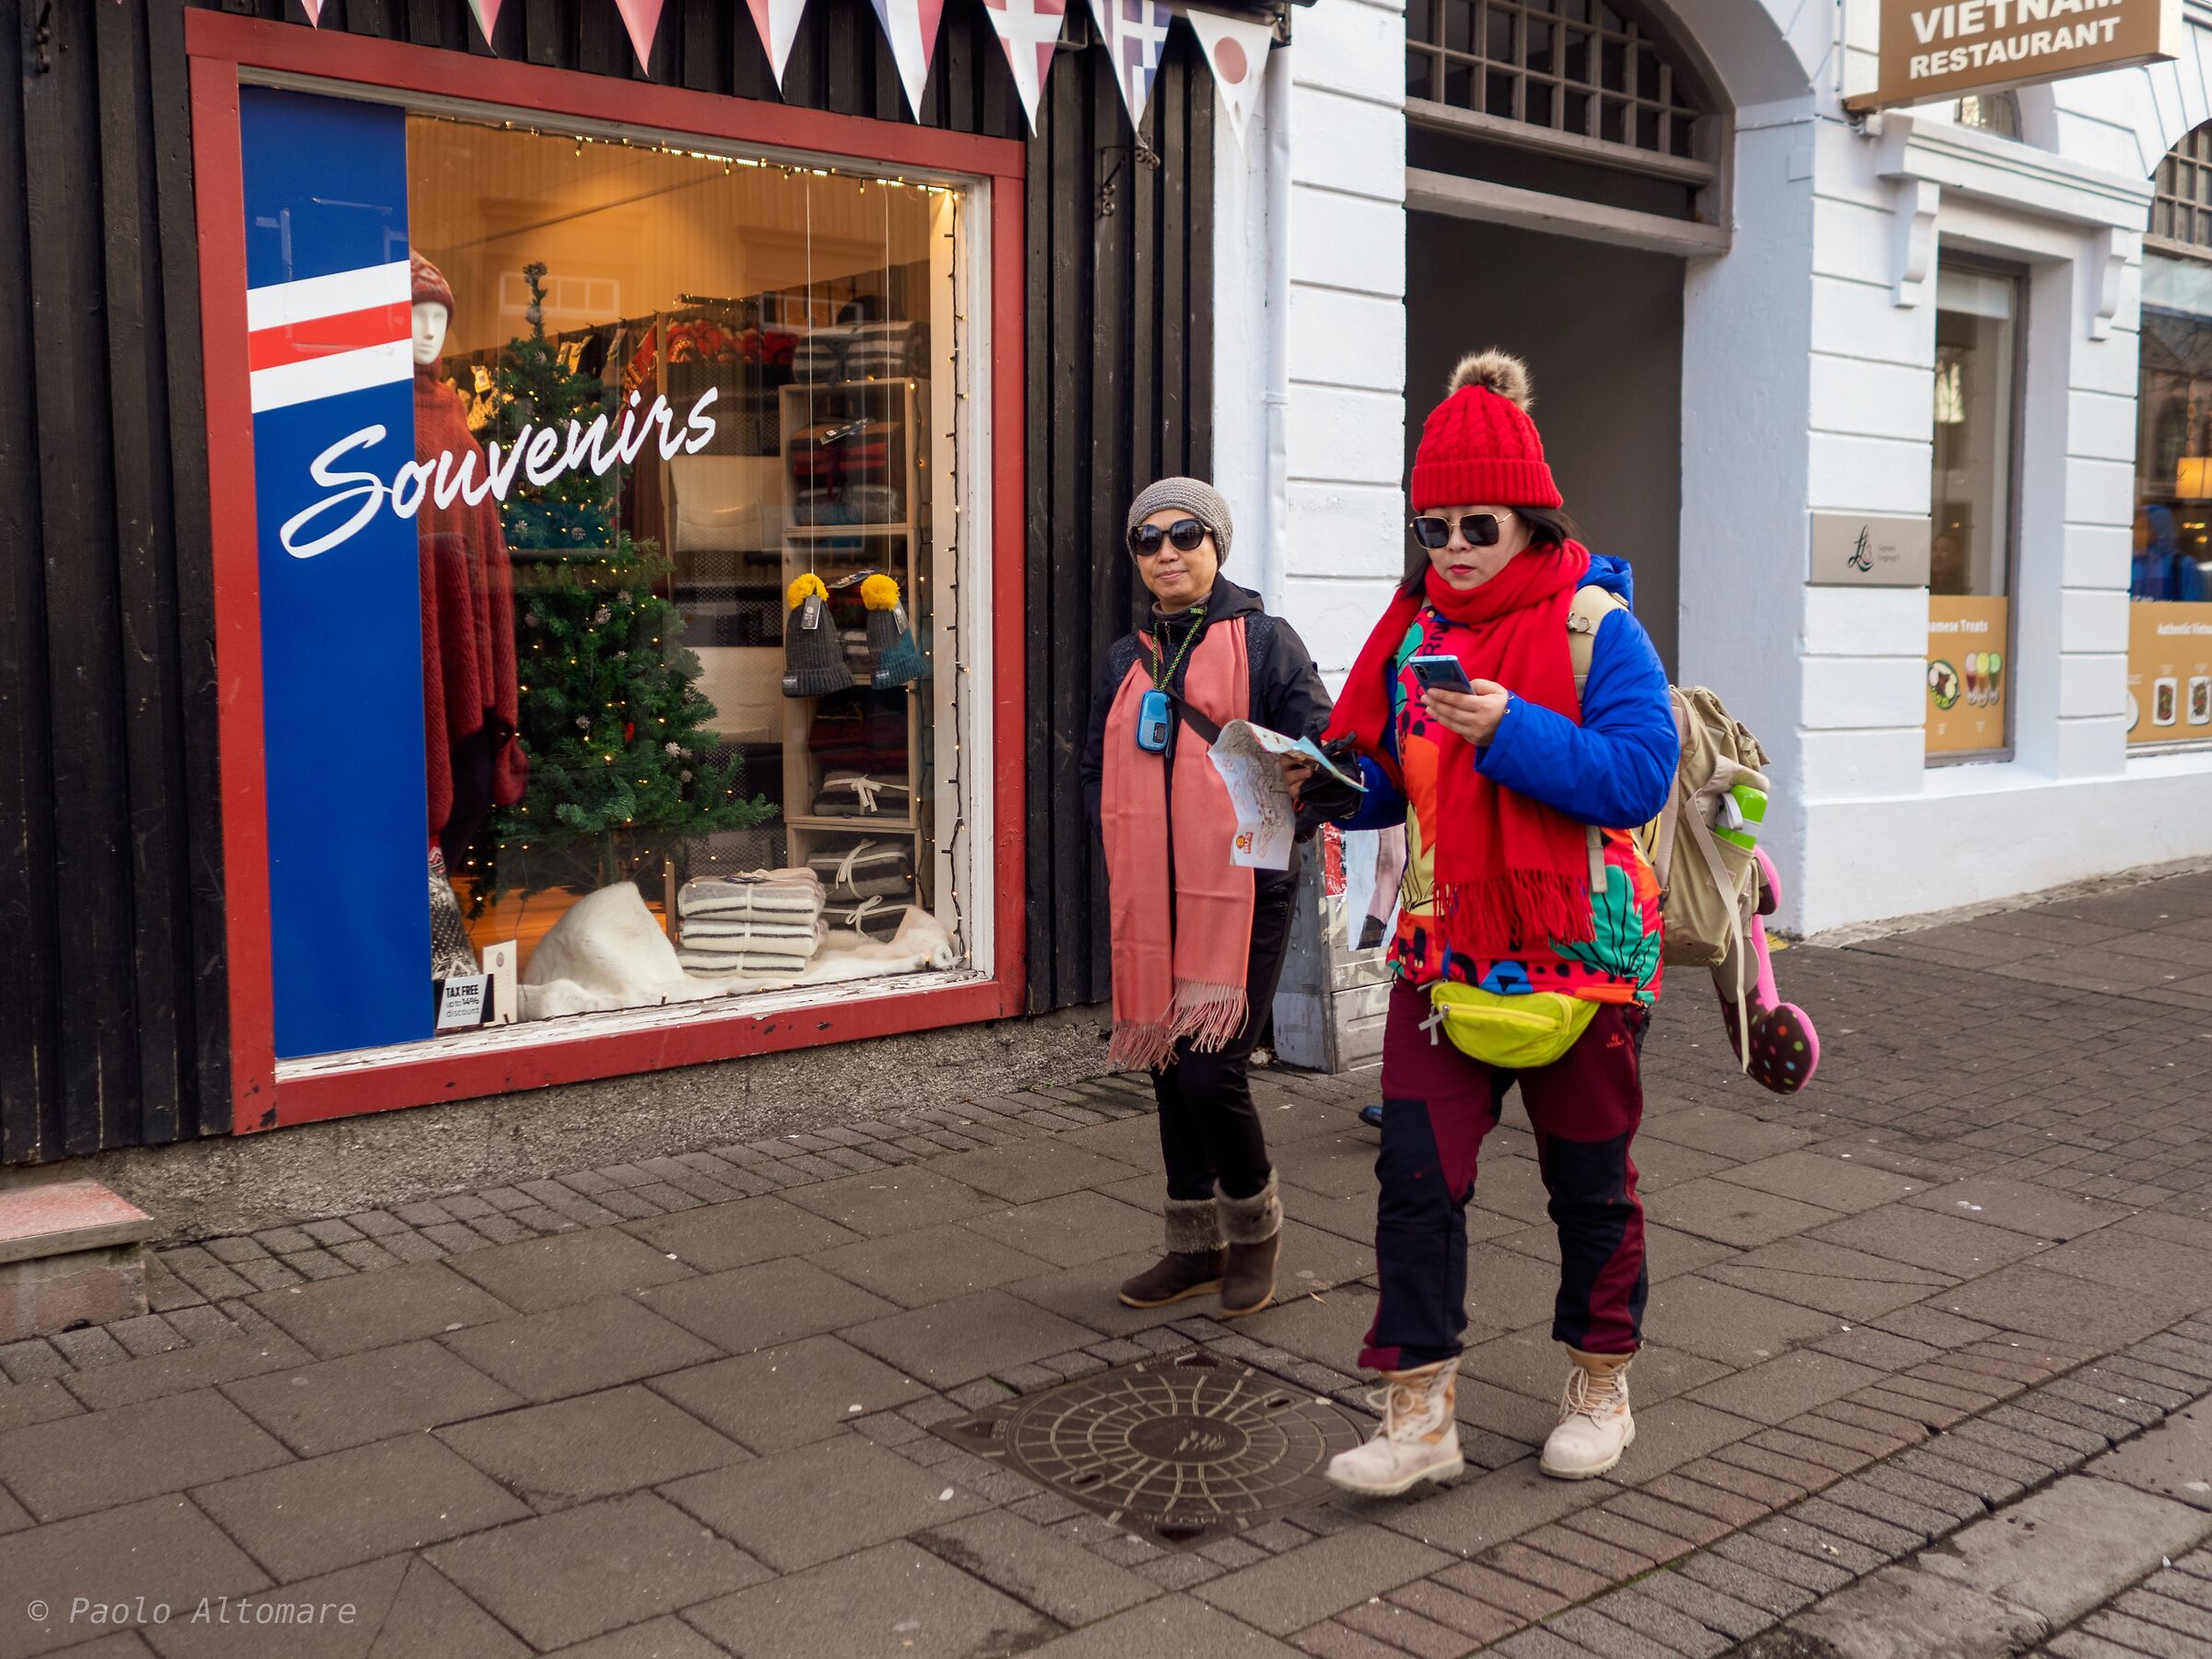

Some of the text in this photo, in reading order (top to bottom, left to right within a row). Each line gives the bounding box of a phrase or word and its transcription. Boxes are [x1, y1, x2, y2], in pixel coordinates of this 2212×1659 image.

[1910, 17, 2121, 79] RESTAURANT
[279, 387, 719, 559] Souvenirs
[446, 984, 478, 997] TAX FREE
[446, 1007, 479, 1018] discount
